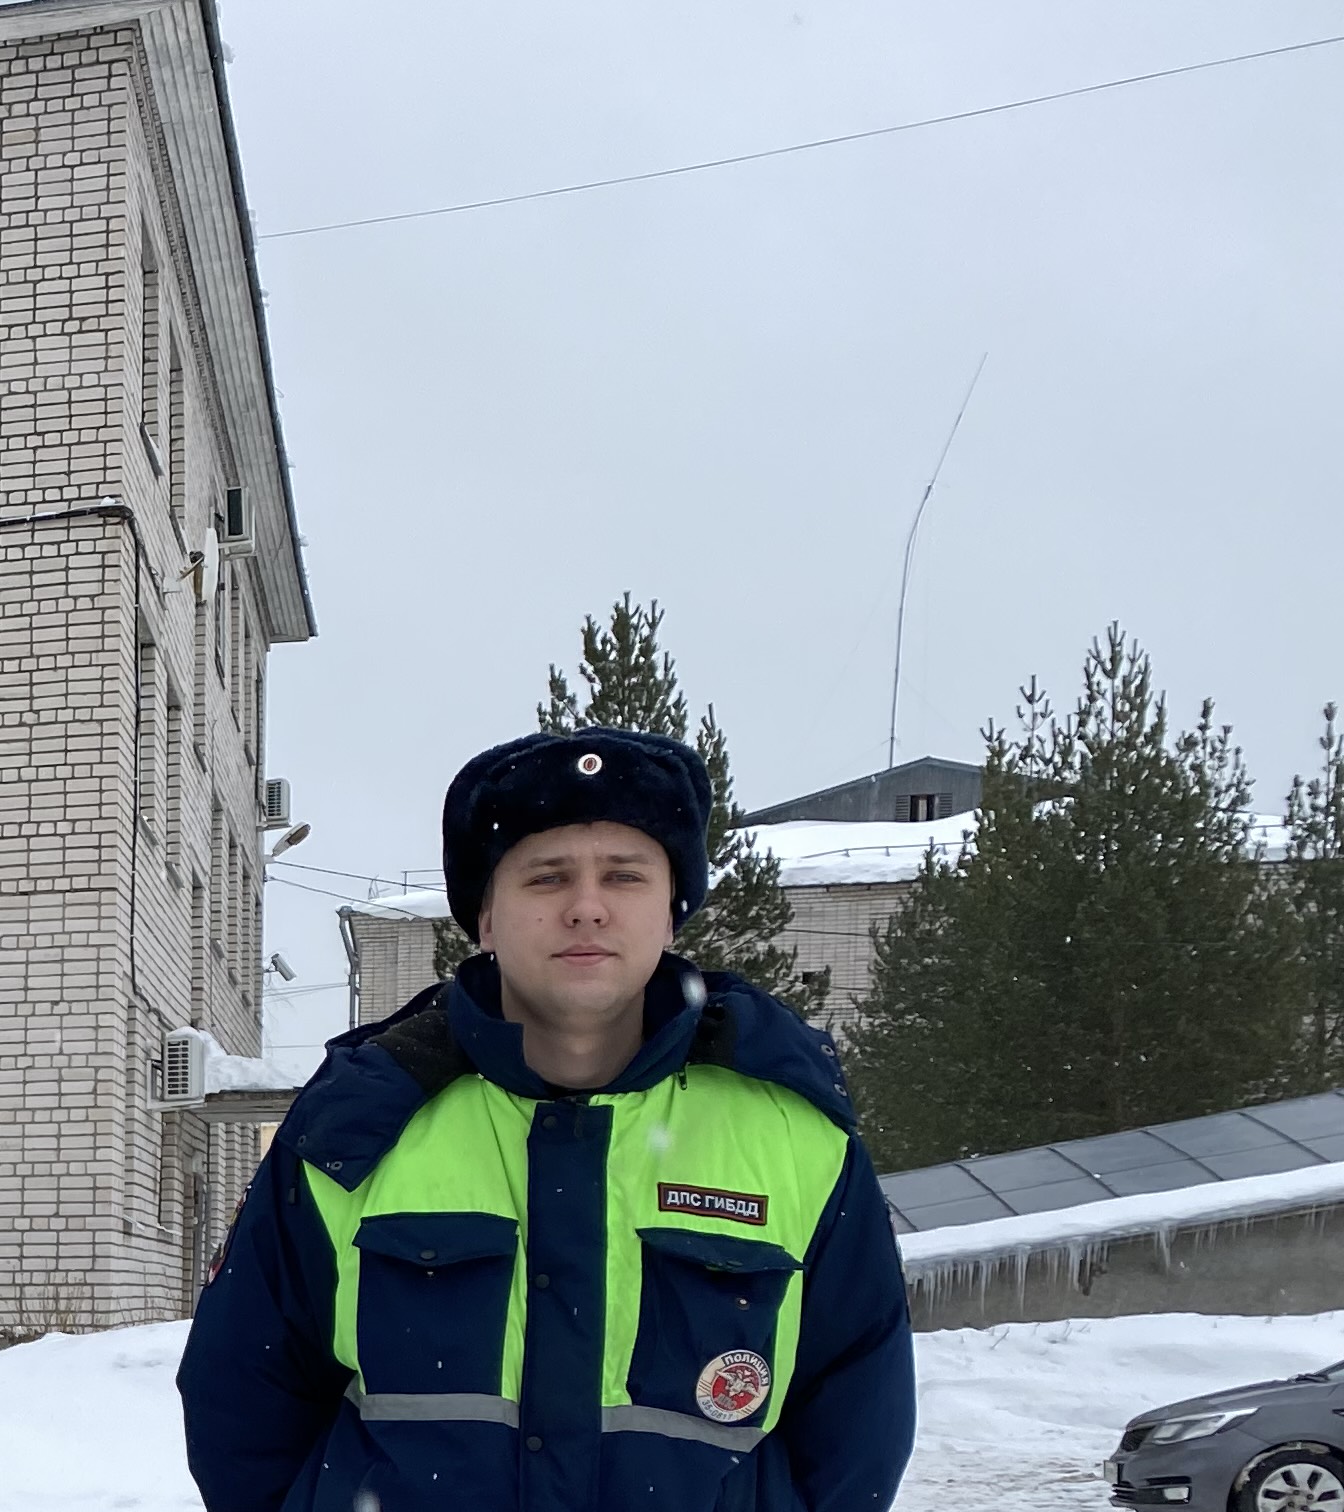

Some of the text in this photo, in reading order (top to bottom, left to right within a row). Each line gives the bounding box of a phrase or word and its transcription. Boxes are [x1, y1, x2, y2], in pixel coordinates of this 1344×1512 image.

[667, 1191, 759, 1218] ДПС ГИБДД
[724, 1353, 769, 1385] ПОЛИЦИЯ
